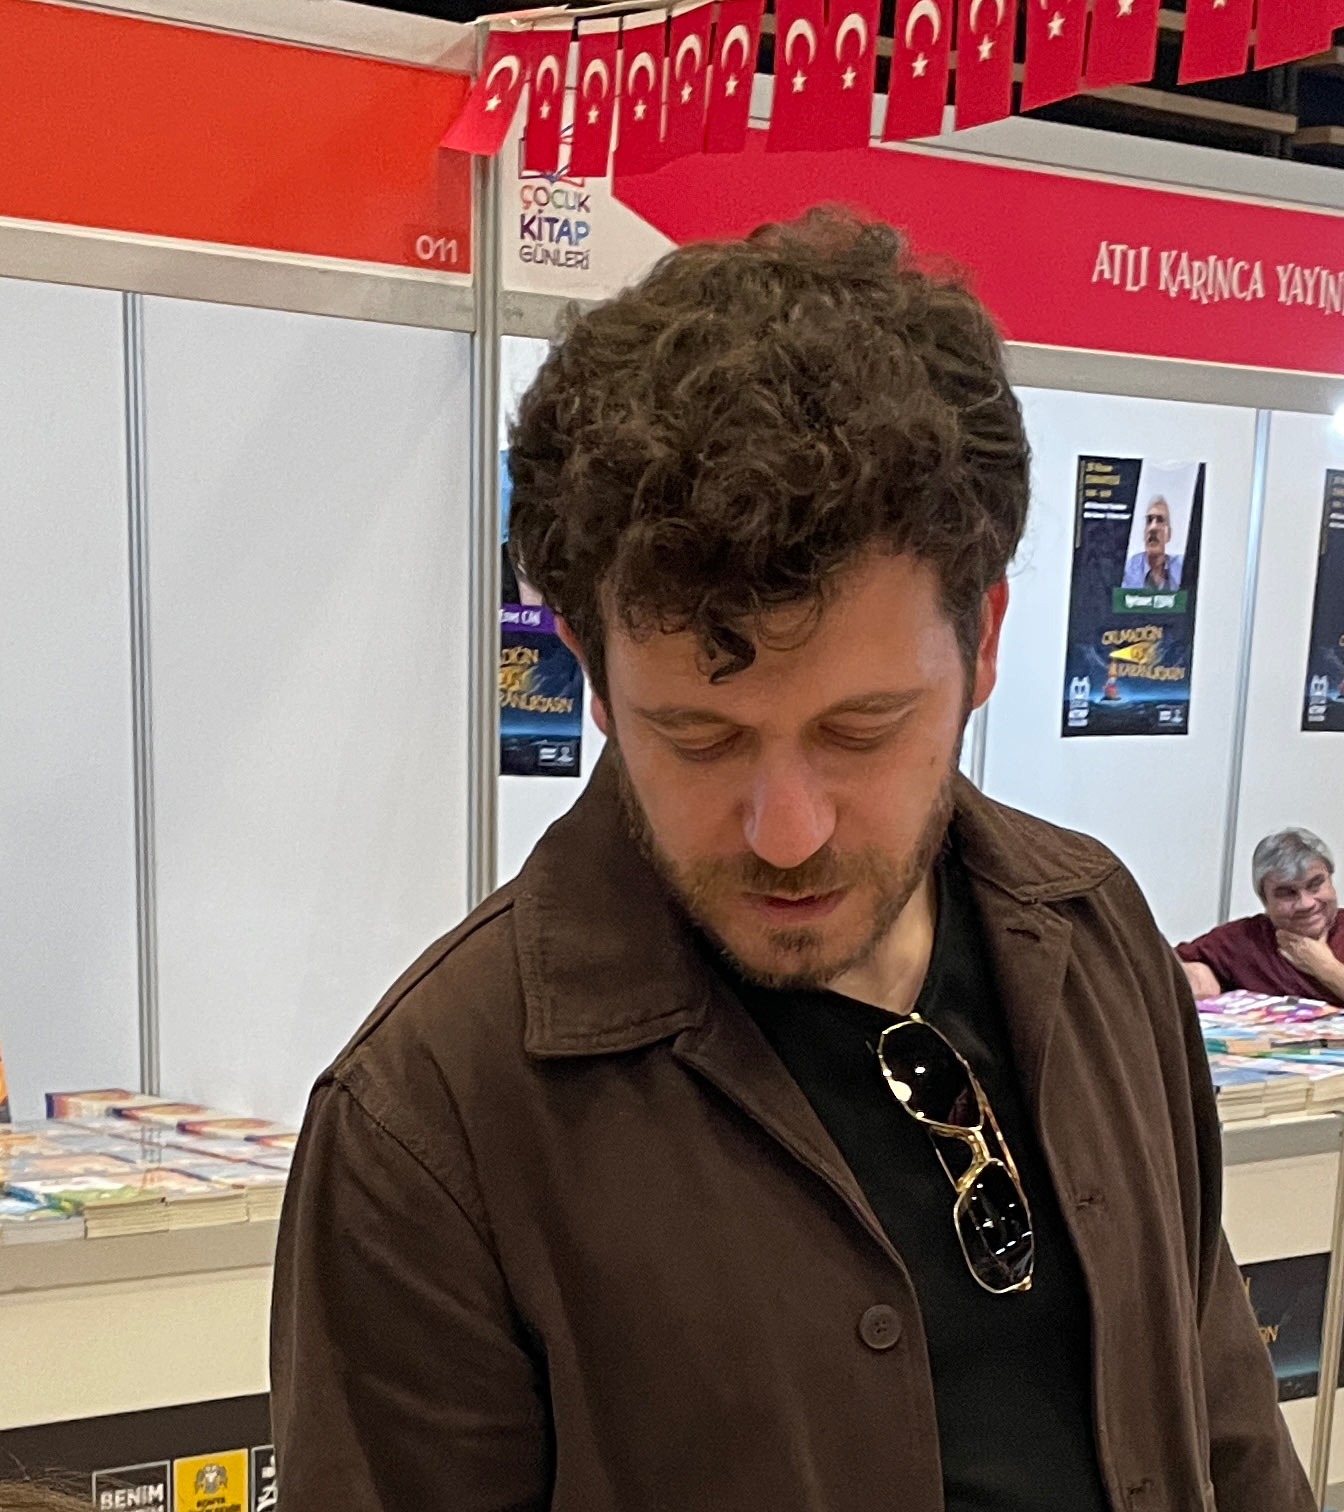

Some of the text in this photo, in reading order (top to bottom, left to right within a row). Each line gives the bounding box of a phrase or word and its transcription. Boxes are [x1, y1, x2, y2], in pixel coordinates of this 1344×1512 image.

[519, 184, 591, 213] ÇOCUK
[519, 209, 590, 246] KİTAP
[416, 235, 457, 264] 011
[1091, 240, 1152, 292] ATLI
[1159, 250, 1265, 304] KARINCA
